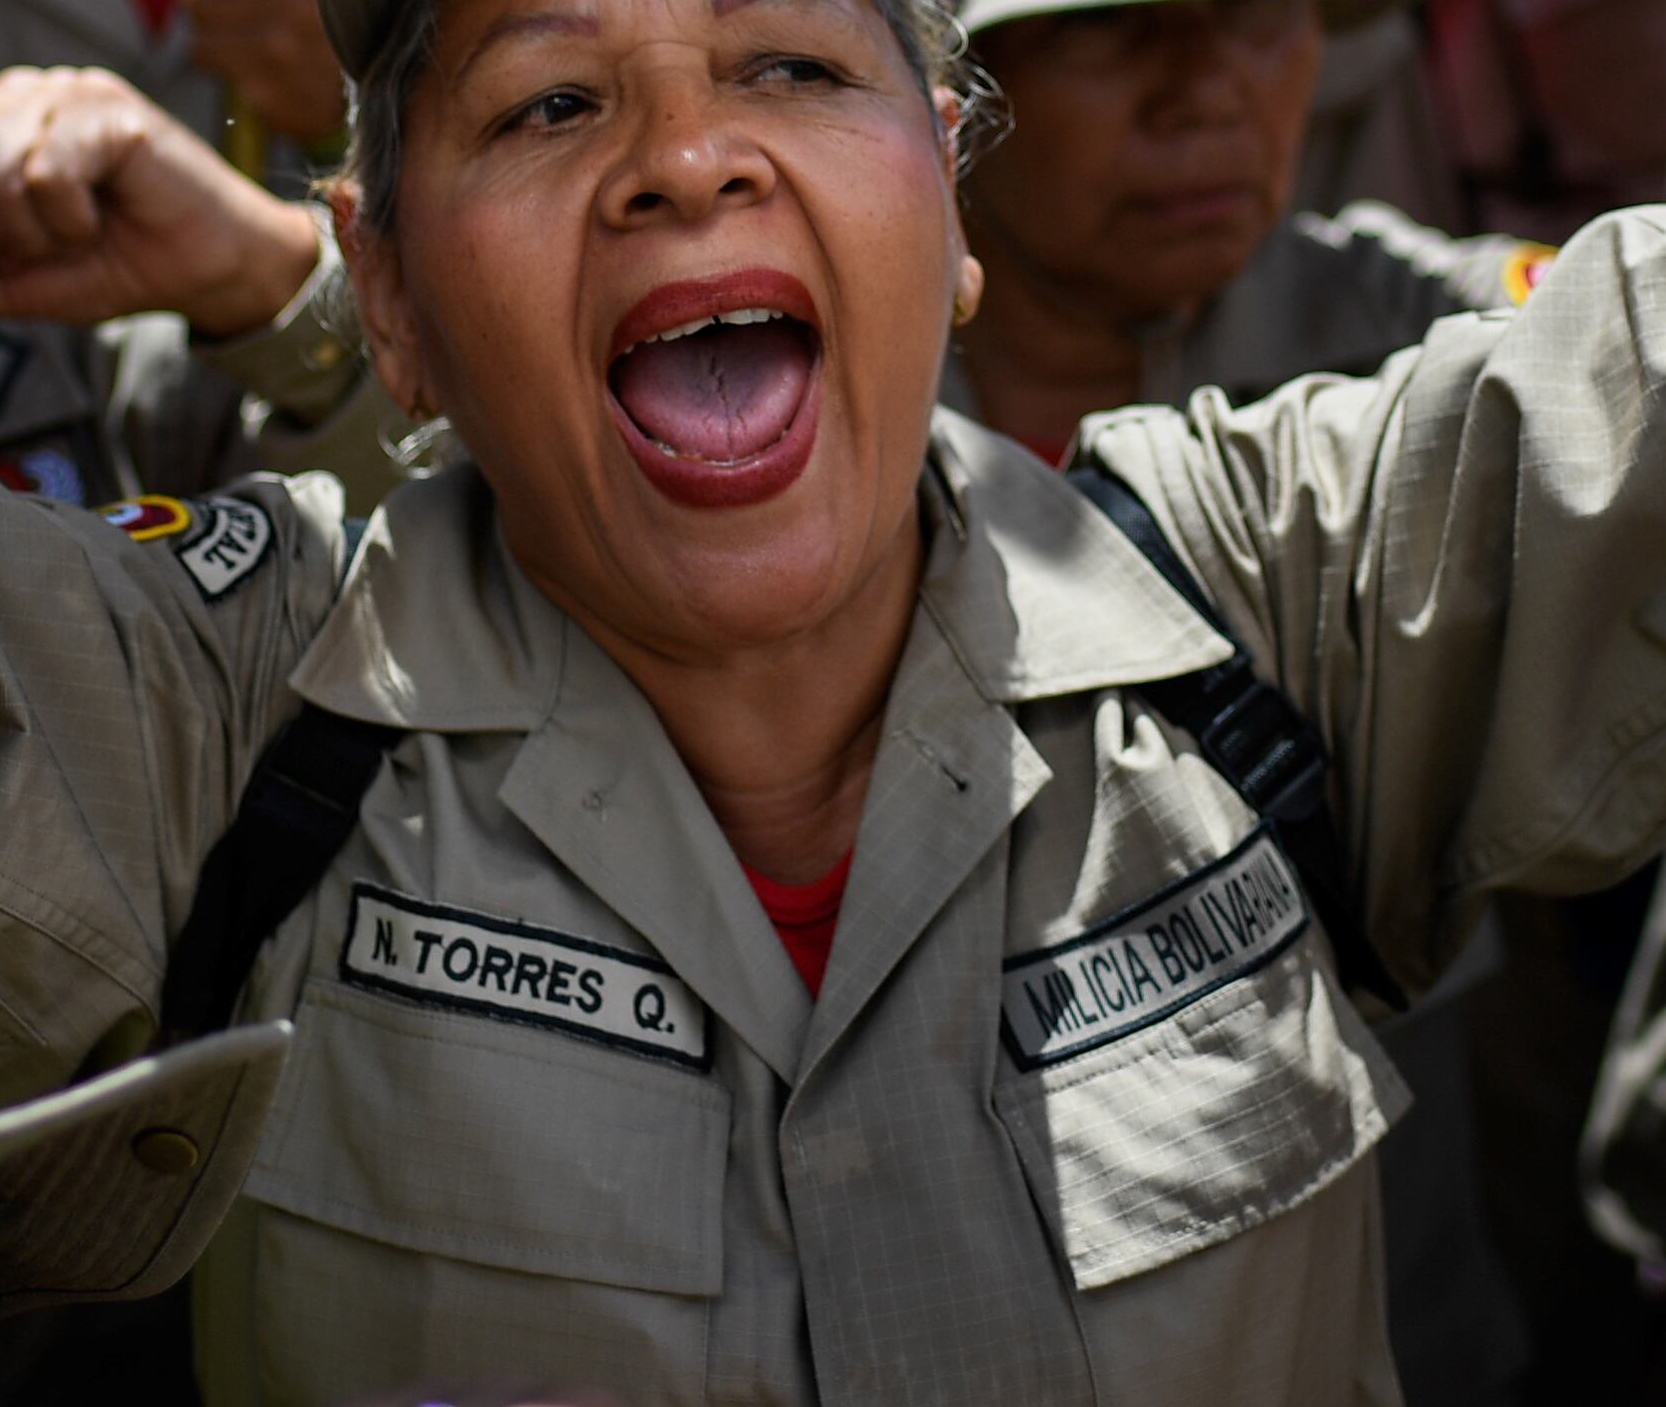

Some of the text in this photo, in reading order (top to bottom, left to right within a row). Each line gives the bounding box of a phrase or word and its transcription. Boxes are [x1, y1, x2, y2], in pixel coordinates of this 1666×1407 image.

[372, 917, 676, 1034] N. TORRES Q.
[1023, 939, 1163, 1040] MILICIA
